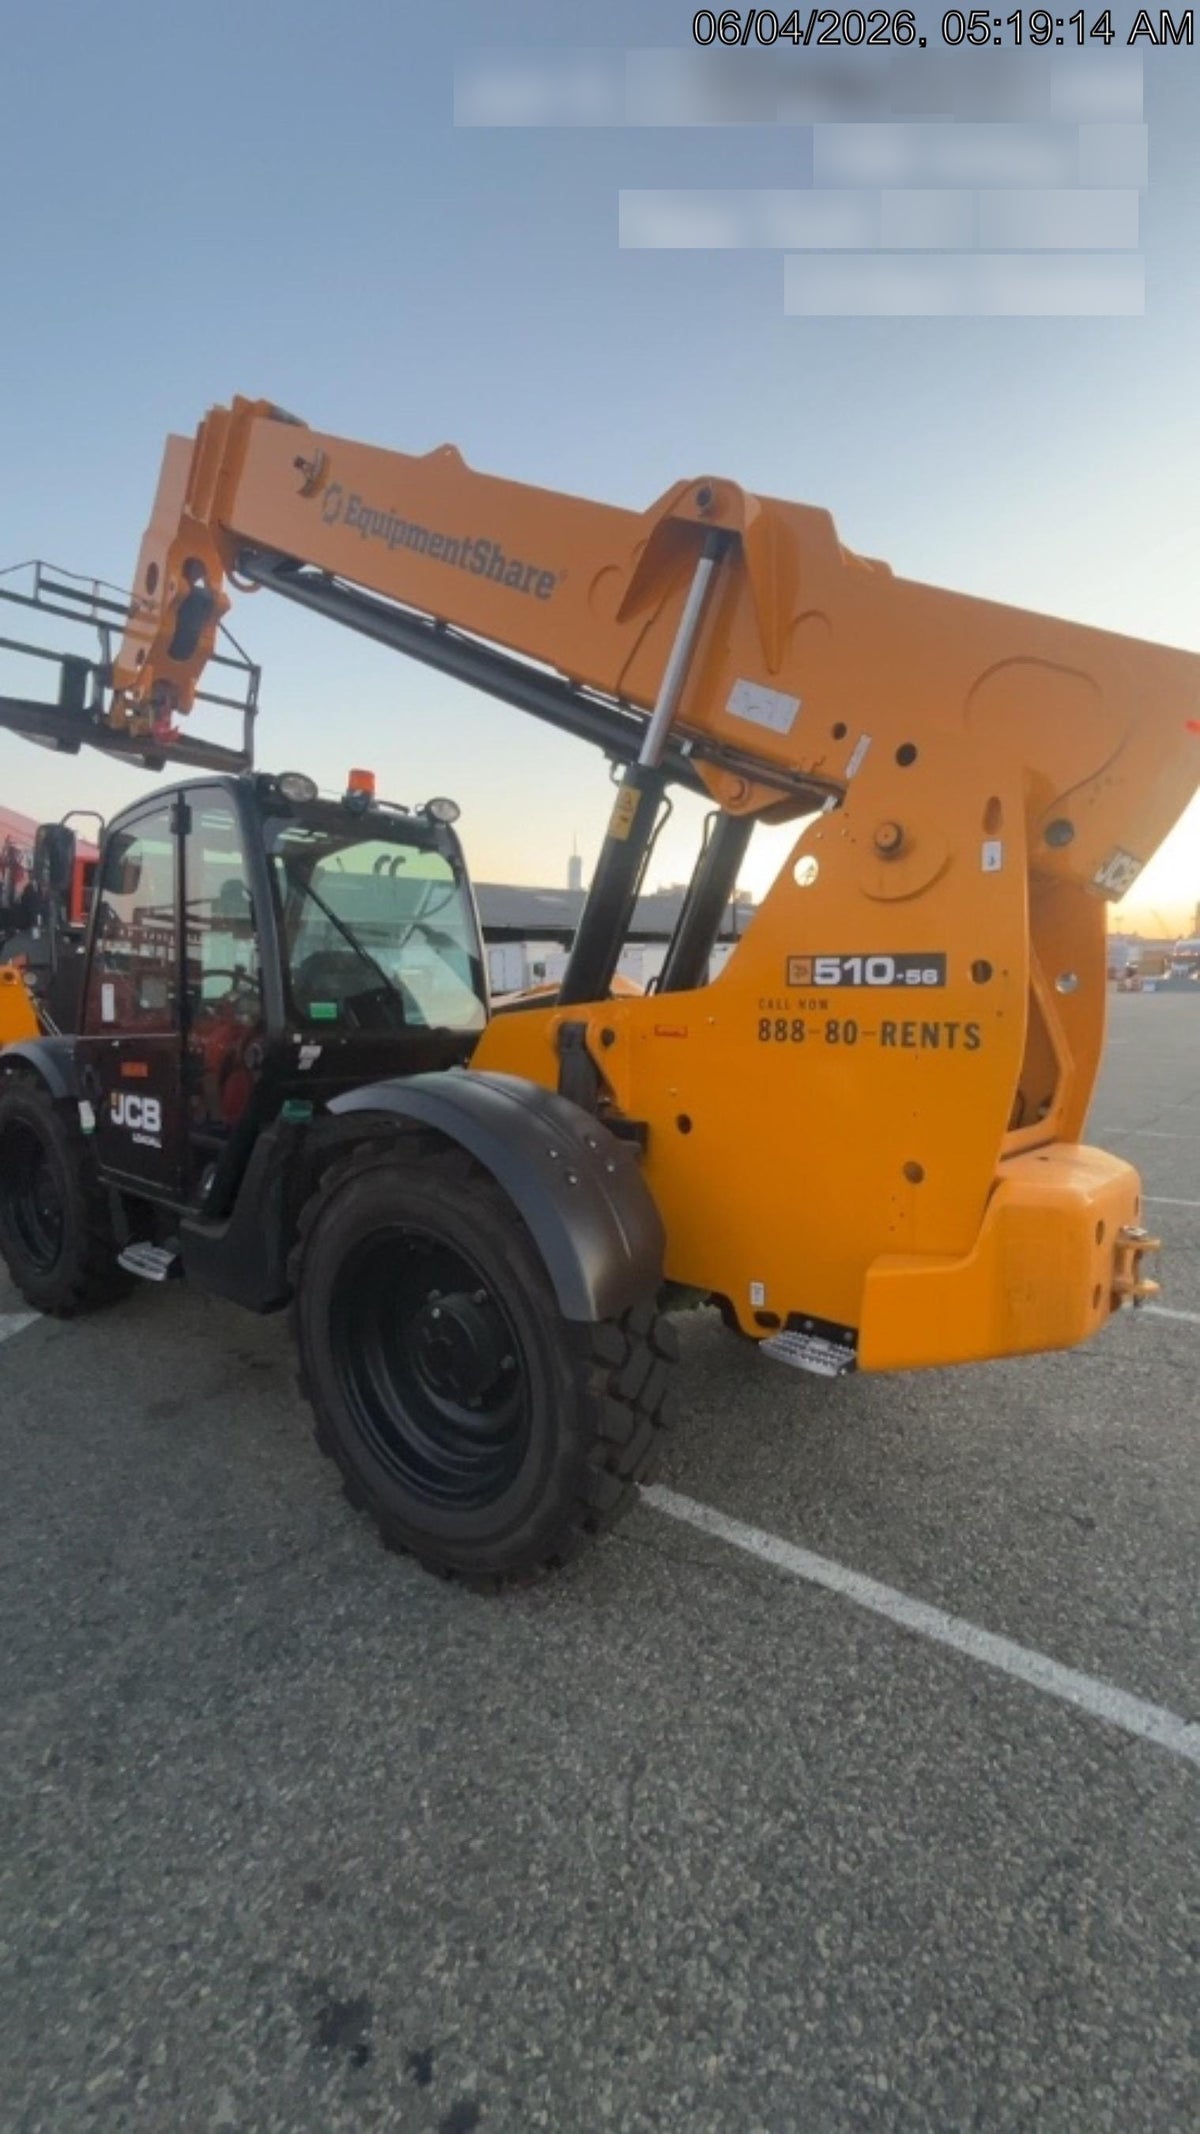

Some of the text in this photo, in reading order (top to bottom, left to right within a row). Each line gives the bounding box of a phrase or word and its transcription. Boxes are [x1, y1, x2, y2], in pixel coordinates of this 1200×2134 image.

[343, 494, 557, 600] EquipmentShare
[758, 998, 790, 1010] CALL
[758, 1017, 981, 1050] 888-80-RENTS
[111, 1092, 161, 1132] JCB
